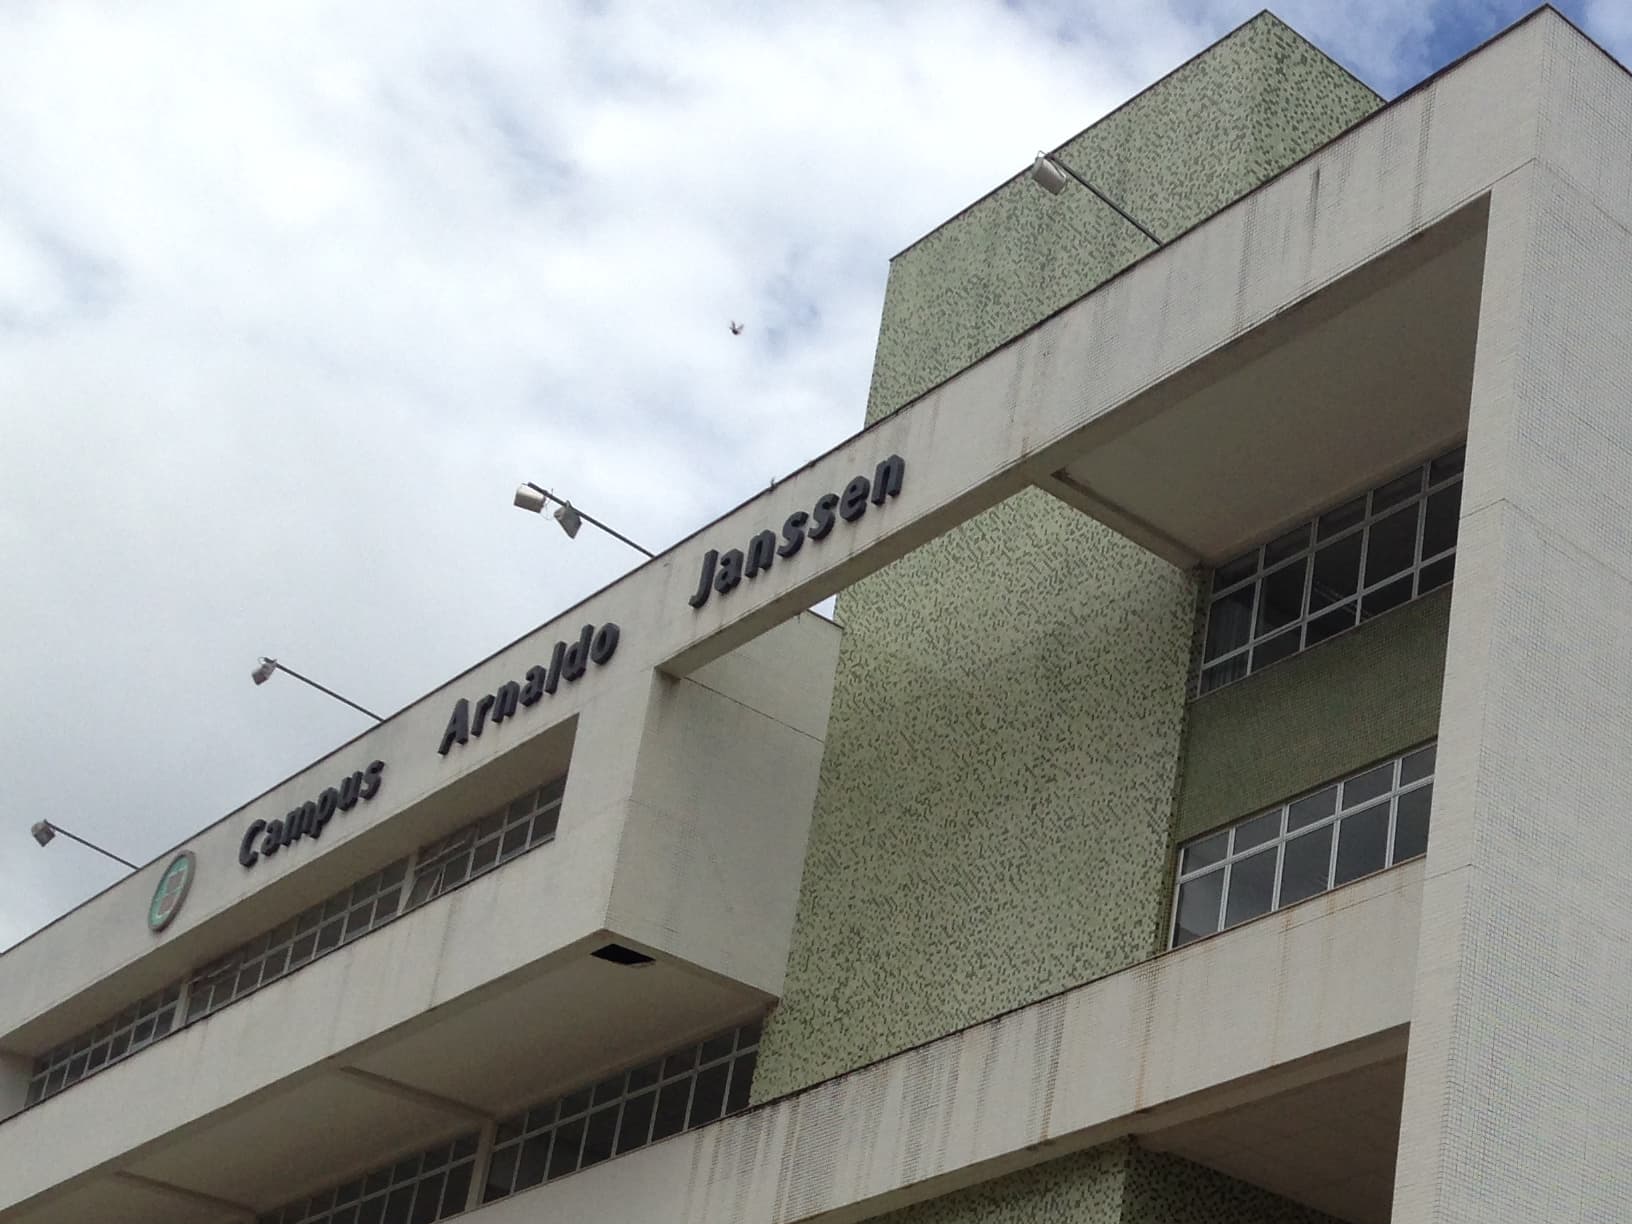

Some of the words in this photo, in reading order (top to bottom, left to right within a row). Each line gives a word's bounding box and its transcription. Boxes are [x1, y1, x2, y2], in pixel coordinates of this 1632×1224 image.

[238, 759, 384, 868] Campus
[437, 621, 620, 756] Arnaldo
[688, 453, 905, 609] Janssen
